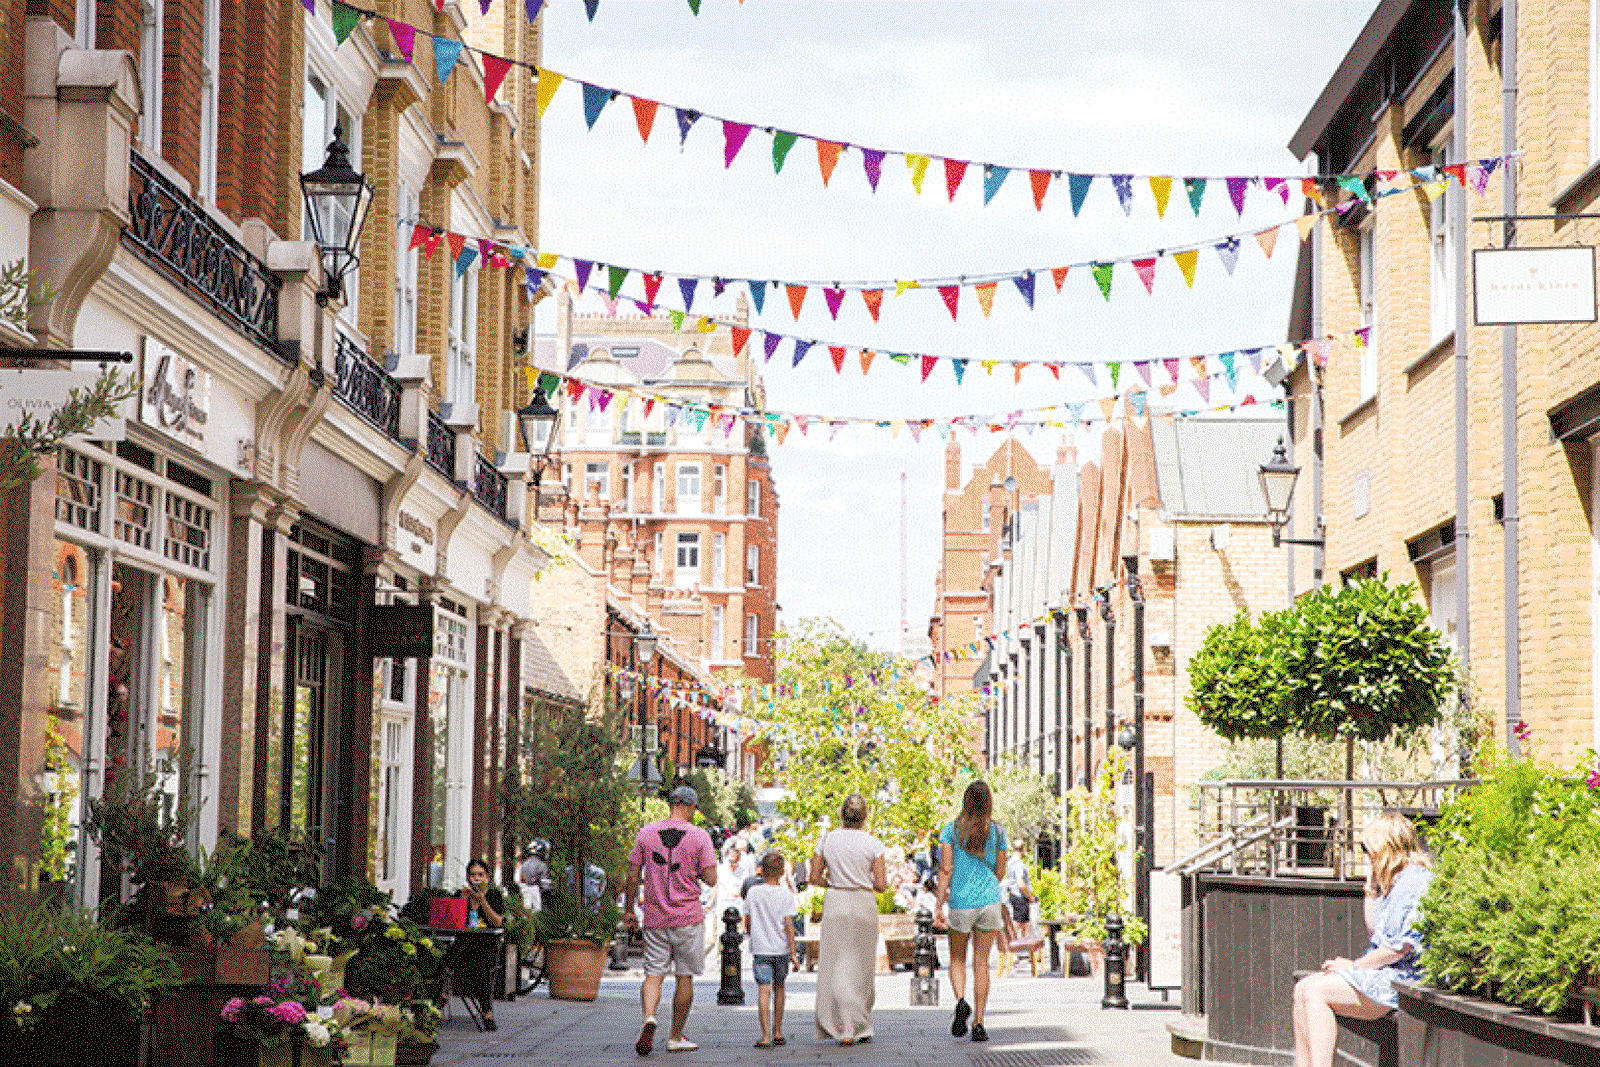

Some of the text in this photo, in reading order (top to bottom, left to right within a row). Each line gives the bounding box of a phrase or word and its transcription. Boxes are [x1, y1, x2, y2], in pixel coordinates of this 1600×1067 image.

[1491, 281, 1579, 291] heidi klein
[8, 398, 52, 409] OLIVIA
